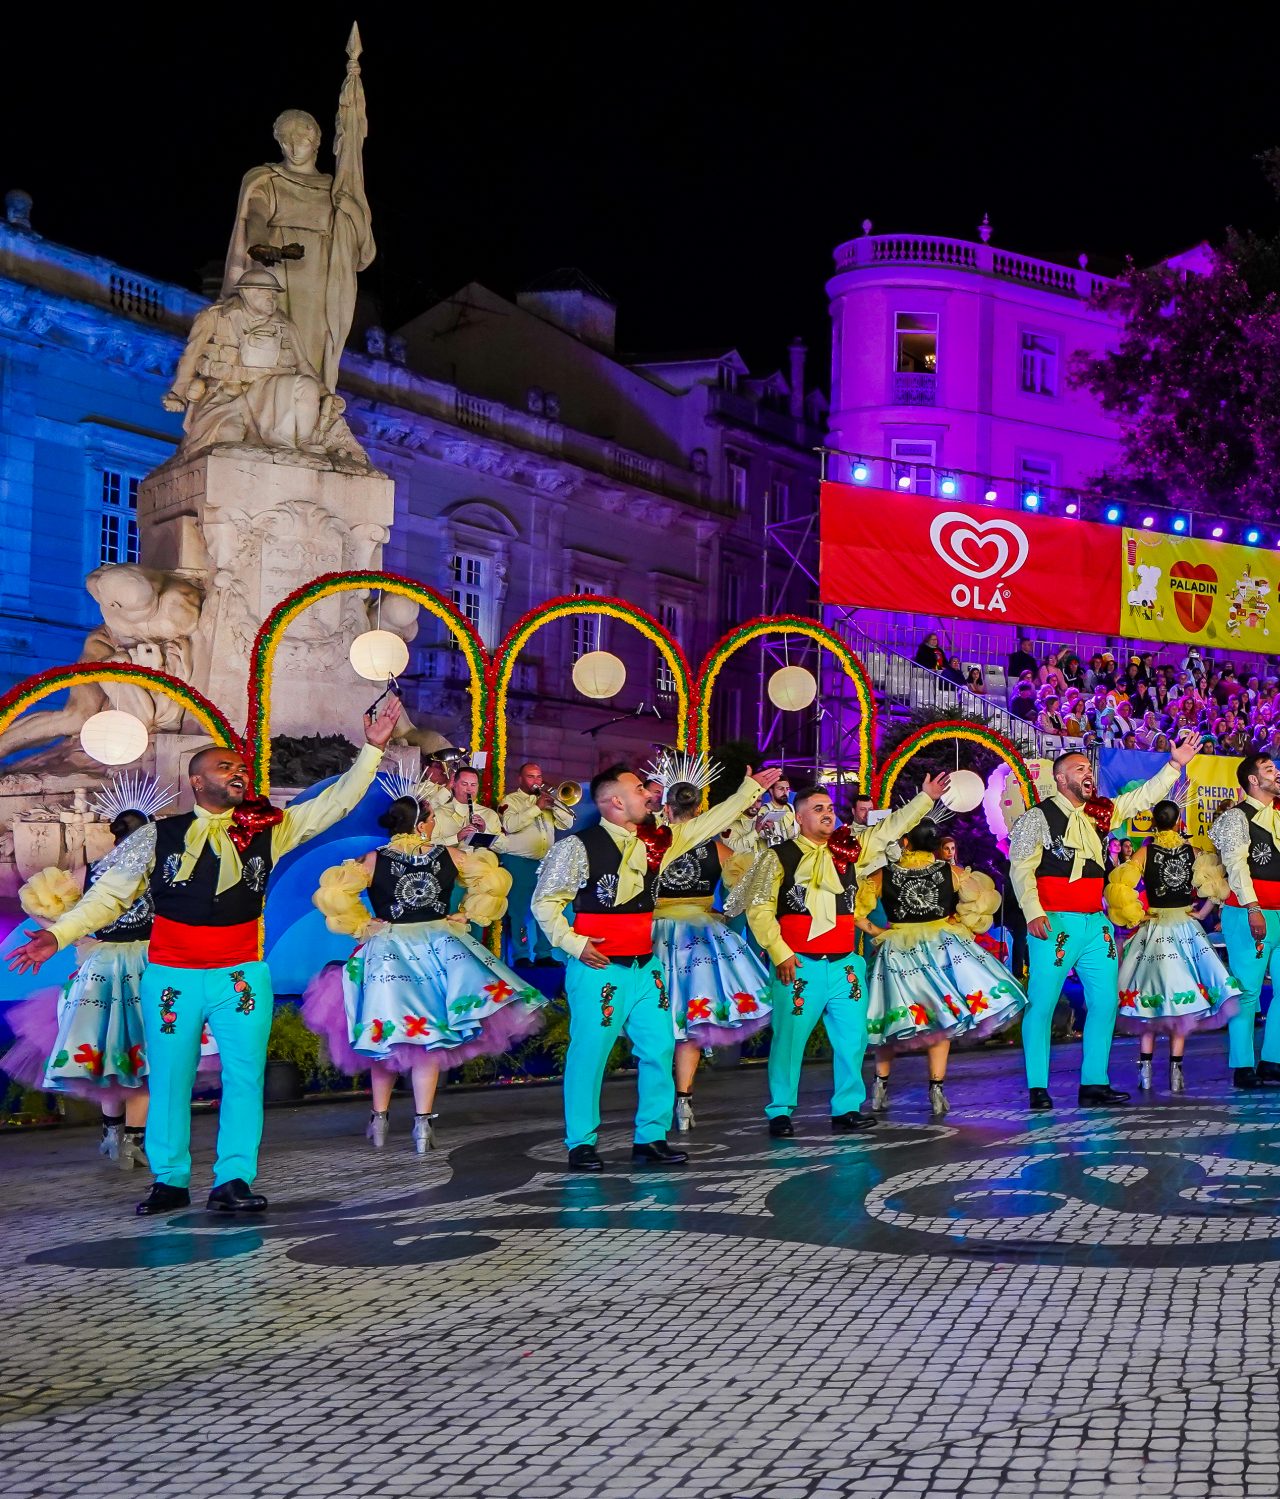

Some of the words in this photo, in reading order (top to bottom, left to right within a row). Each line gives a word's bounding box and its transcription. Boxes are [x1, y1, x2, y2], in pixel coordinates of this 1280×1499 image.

[1170, 578, 1217, 595] PALADIN
[1198, 786, 1235, 798] CHEIRA
[1198, 799, 1205, 810] A
[1198, 825, 1205, 837] A
